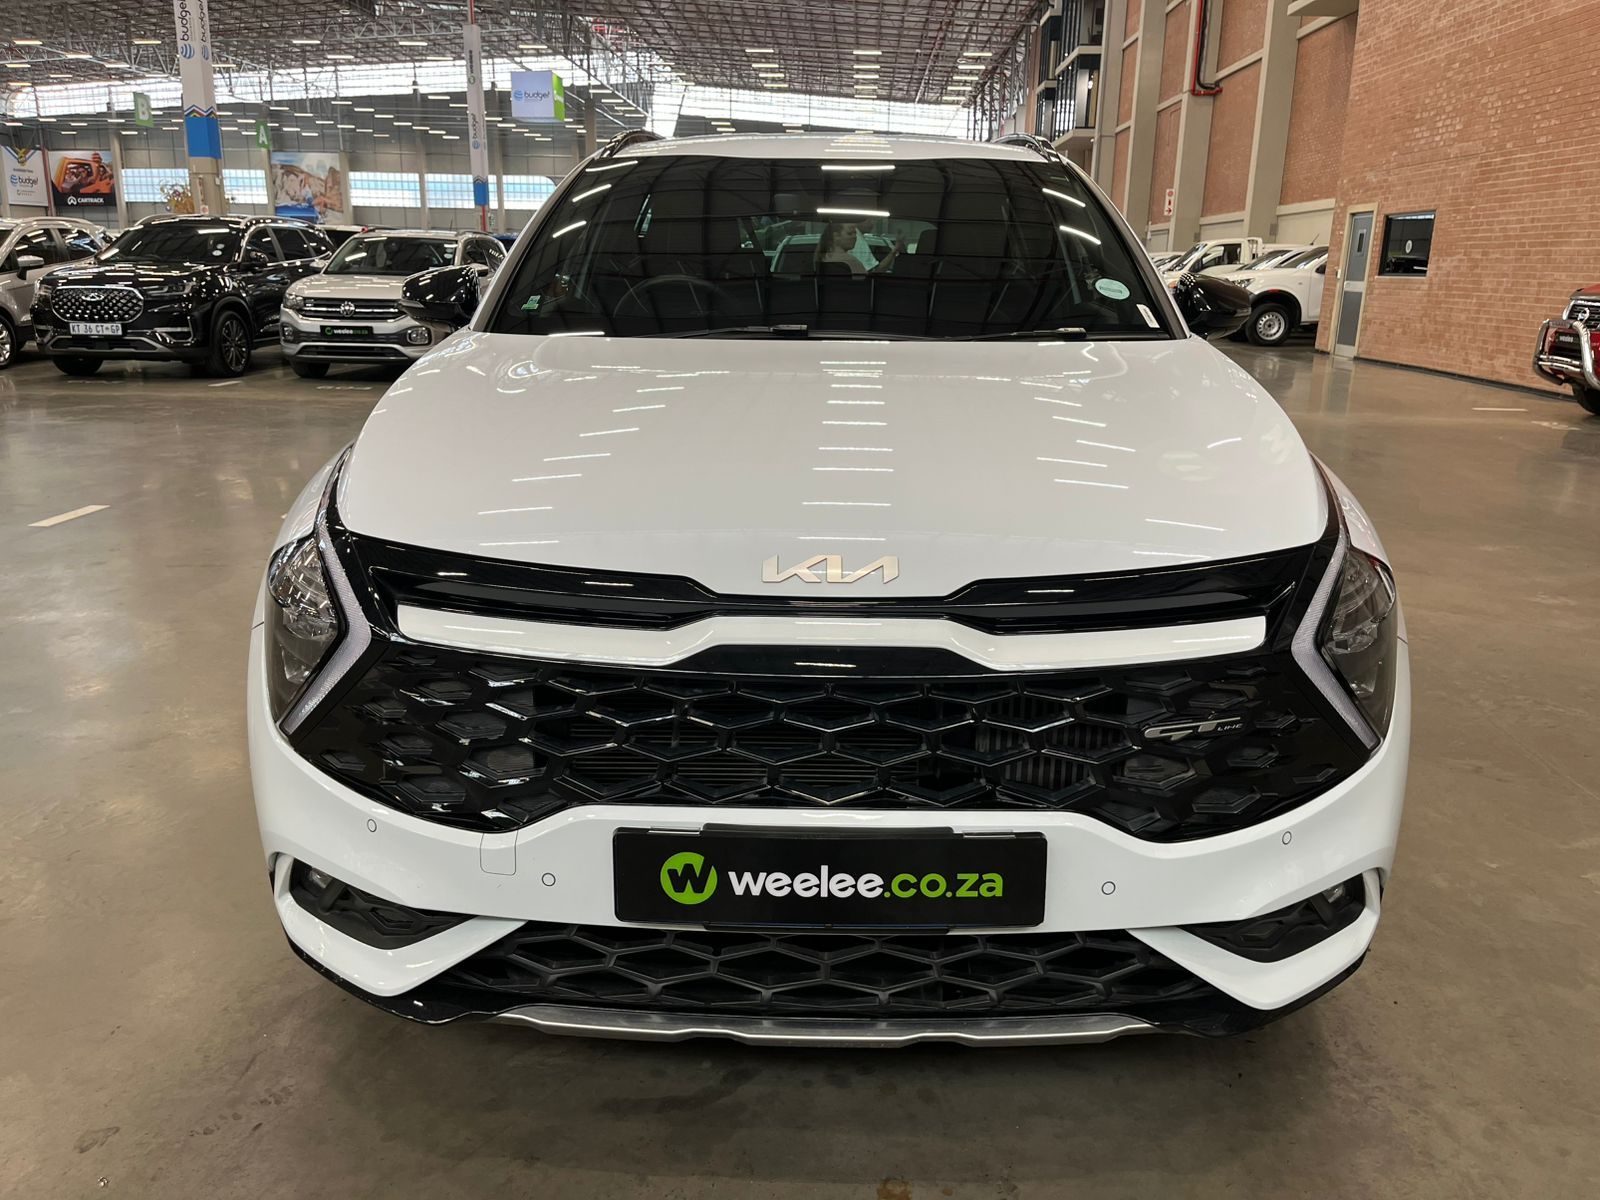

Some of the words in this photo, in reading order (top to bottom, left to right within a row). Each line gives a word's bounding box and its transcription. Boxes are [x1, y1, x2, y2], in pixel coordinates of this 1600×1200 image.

[179, 0, 191, 42] budge
[258, 125, 268, 145] A
[72, 325, 80, 333] KT
[84, 325, 93, 333] 36
[95, 325, 104, 333] CT
[762, 554, 899, 584] KIA
[728, 865, 1003, 898] weelee.co.za
